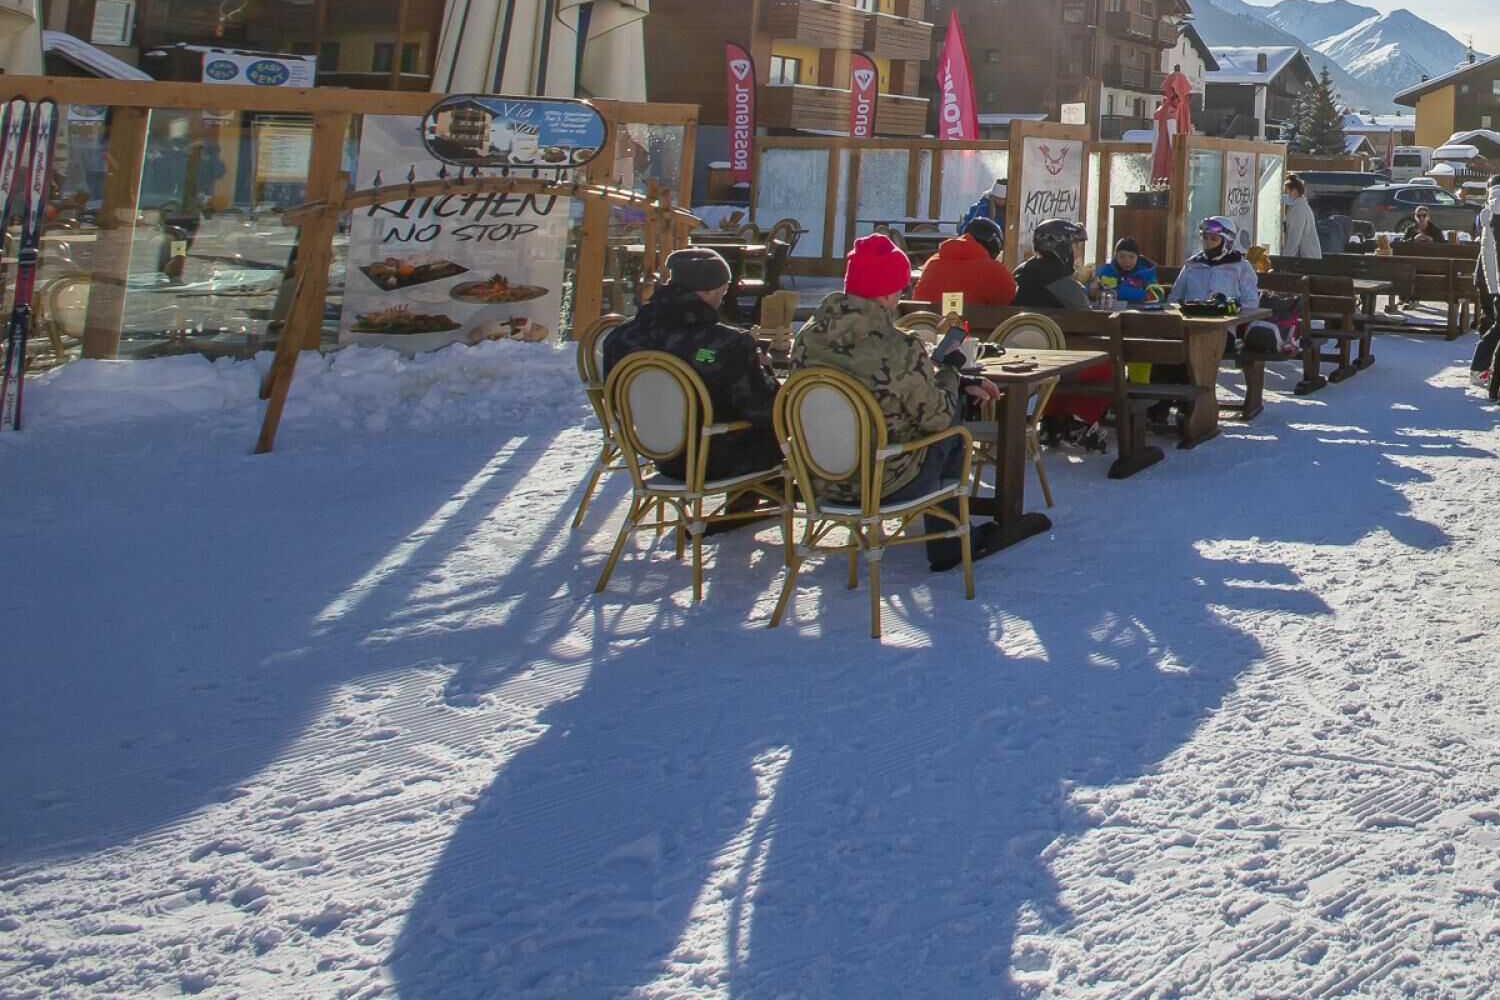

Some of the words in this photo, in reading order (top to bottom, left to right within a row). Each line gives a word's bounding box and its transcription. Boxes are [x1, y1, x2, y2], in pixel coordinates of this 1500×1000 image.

[256, 63, 282, 73] EASY
[250, 70, 284, 84] RENT
[503, 102, 535, 119] Via
[1024, 188, 1077, 216] KITCHEN
[383, 223, 441, 242] NO
[451, 223, 538, 242] STOP
